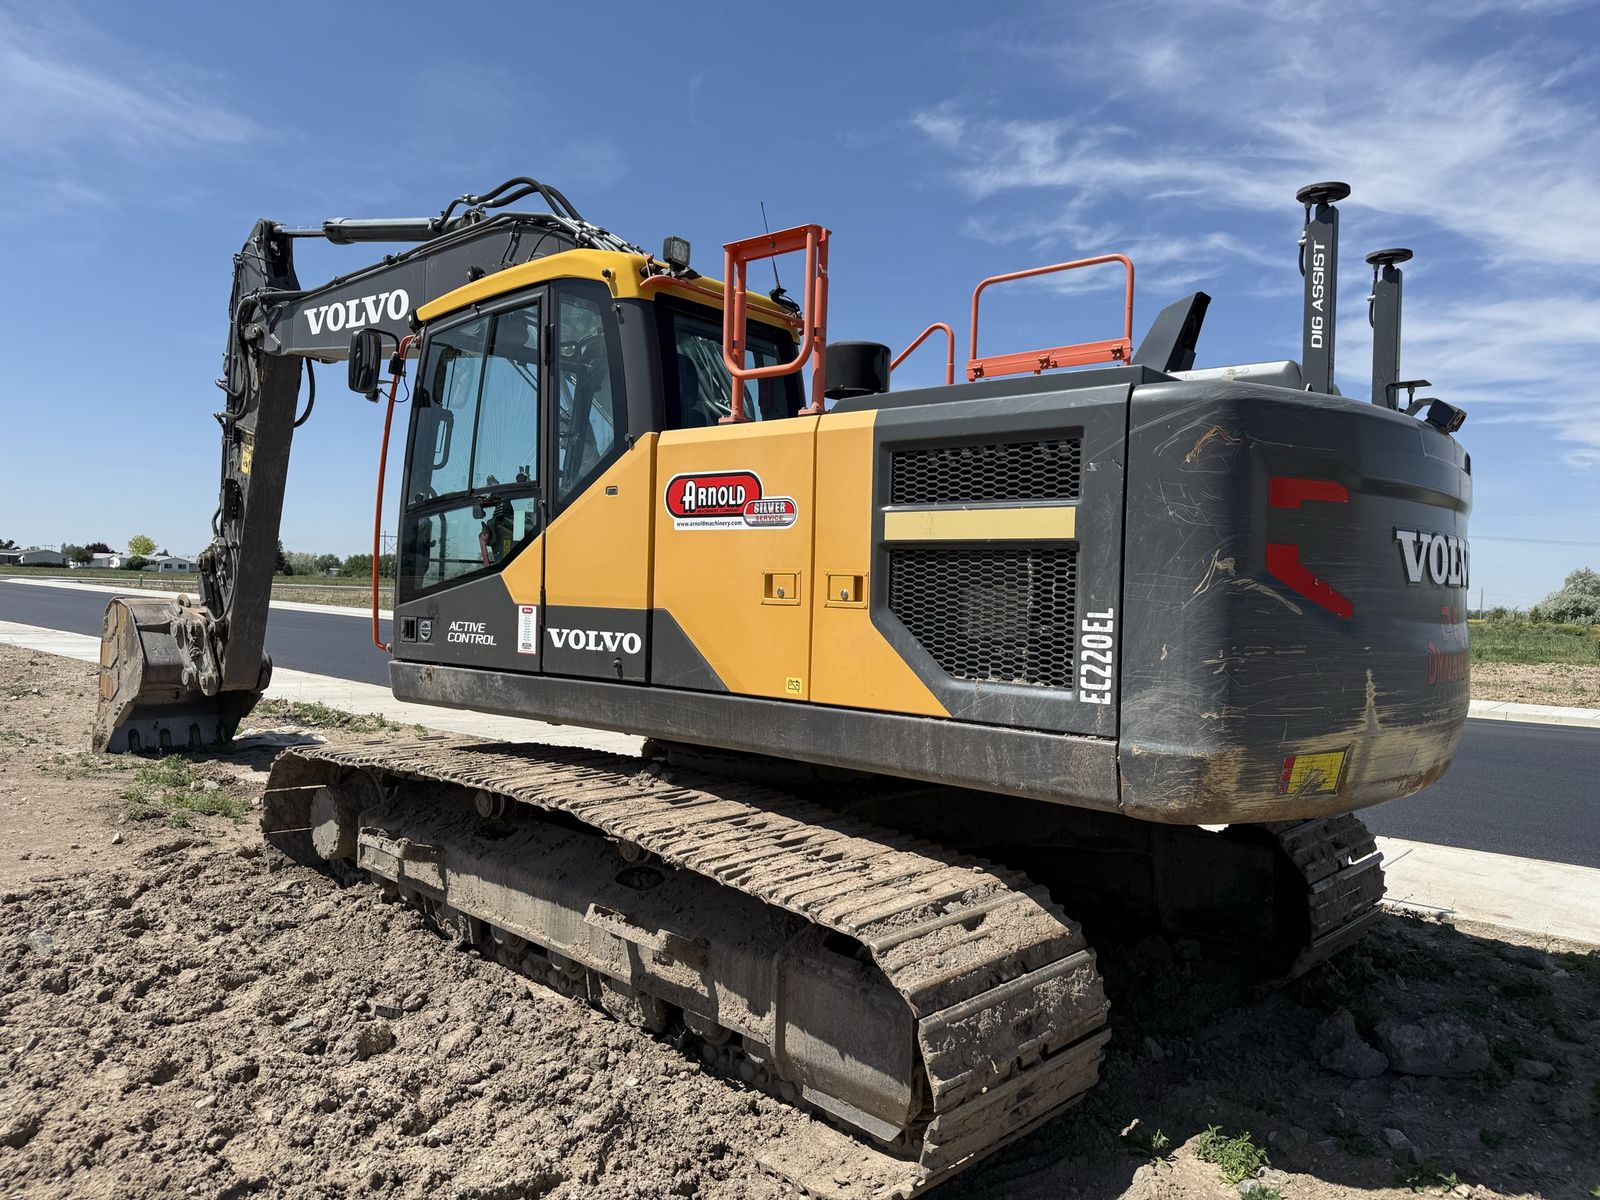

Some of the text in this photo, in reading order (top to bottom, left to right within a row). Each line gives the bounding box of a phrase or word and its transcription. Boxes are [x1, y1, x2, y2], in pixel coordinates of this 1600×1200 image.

[1311, 241, 1325, 349] DIG ASSIST
[303, 288, 410, 336] VOLVO
[682, 480, 746, 511] ARNOLD
[753, 501, 786, 514] SILVER
[676, 519, 743, 528] www.arnoldmachinery.com
[1396, 529, 1470, 589] VOLV
[447, 632, 497, 646] CONTROL
[449, 621, 486, 633] ACTIVE
[547, 627, 642, 655] VOLVO
[1079, 607, 1114, 705] EC220EL
